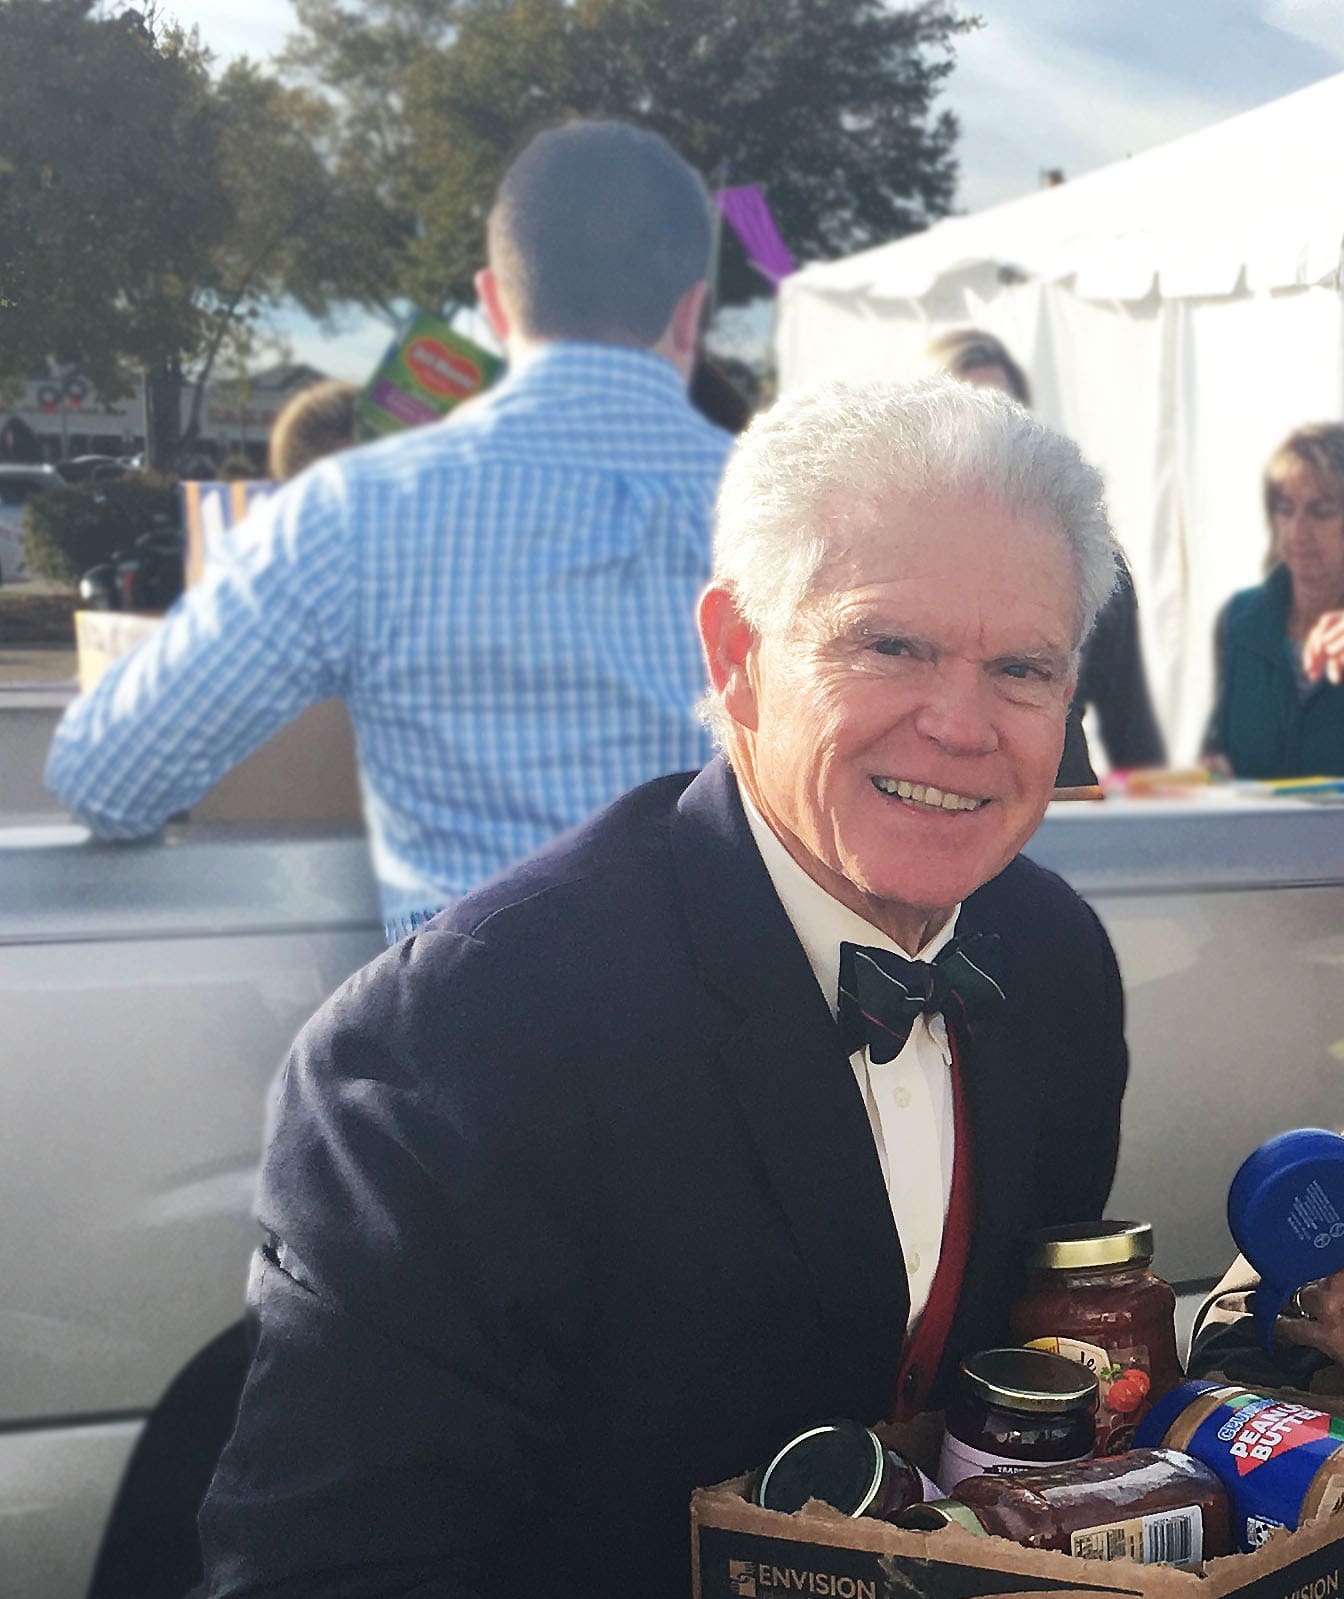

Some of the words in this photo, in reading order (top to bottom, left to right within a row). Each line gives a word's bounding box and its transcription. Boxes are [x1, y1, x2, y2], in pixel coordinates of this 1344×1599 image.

[1217, 1399, 1275, 1441] CRUN
[1229, 1402, 1305, 1459] PEANU
[1250, 1407, 1326, 1462] BUTTE
